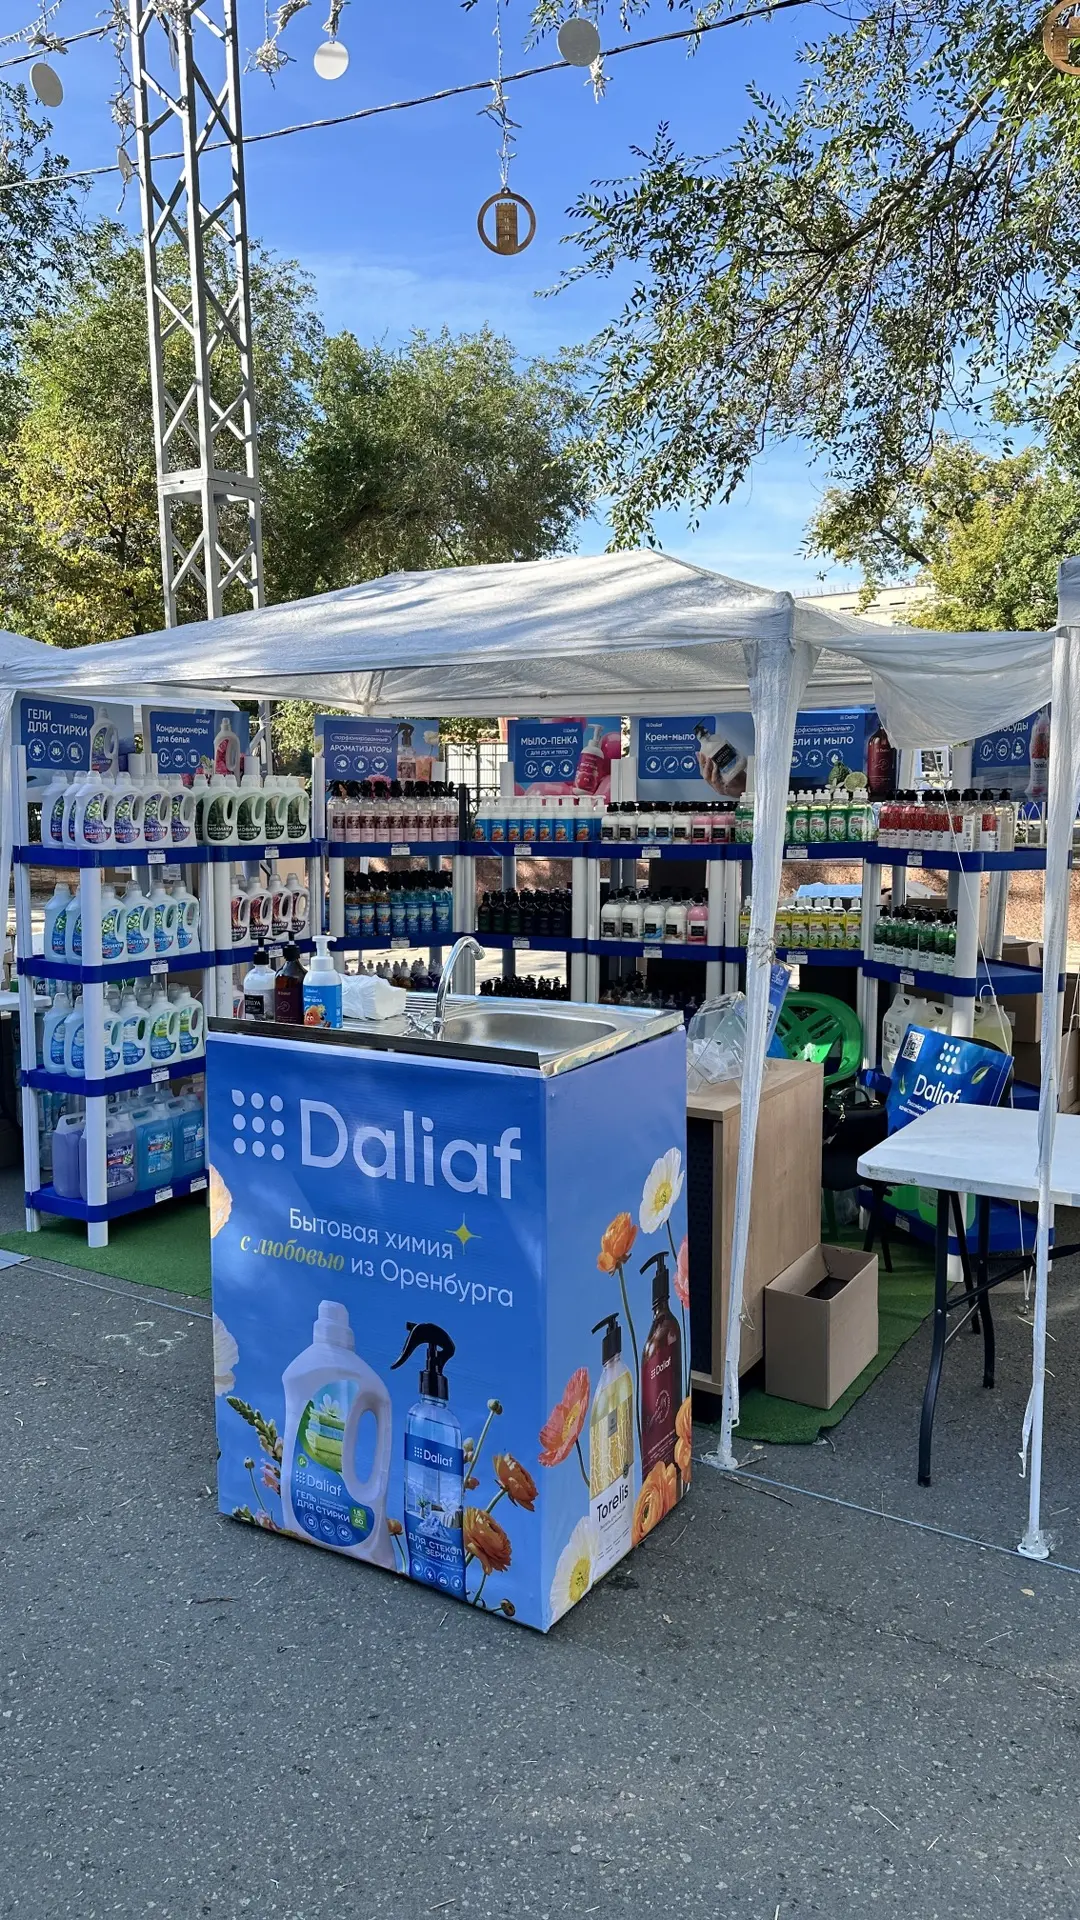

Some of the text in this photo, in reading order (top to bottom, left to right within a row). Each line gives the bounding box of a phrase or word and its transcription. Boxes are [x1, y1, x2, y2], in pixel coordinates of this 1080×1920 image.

[27, 708, 52, 721] ГЕЛИ
[27, 721, 88, 736] ДЛЯ СТИРКИ
[155, 723, 209, 736] Кондиционеры
[645, 732, 696, 743] Крем-мыло
[156, 735, 190, 744] для белья
[330, 744, 393, 754] АРОМАТИЗАТОРЫ
[520, 735, 578, 746] МЫЛО-ПЕНКА
[793, 738, 811, 747] ели
[823, 736, 854, 745] мыло
[913, 1074, 962, 1104] Daliaf
[300, 1098, 522, 1200] Daliaf
[289, 1207, 454, 1260] Бытовая химия
[240, 1235, 514, 1308] с любовью из Оренбурга
[423, 1449, 453, 1468] Daliaf
[306, 1474, 342, 1497] Daliaf
[296, 1489, 317, 1503] ГЕЛЬ
[596, 1484, 629, 1523] Torelis
[296, 1498, 315, 1511] ДЛЯ
[315, 1505, 351, 1523] СТИРКИ
[408, 1531, 463, 1557] ДЛЯ СТЕКОЛ
[415, 1543, 423, 1551] И
[426, 1547, 458, 1563] ЗЕРКАЛ
